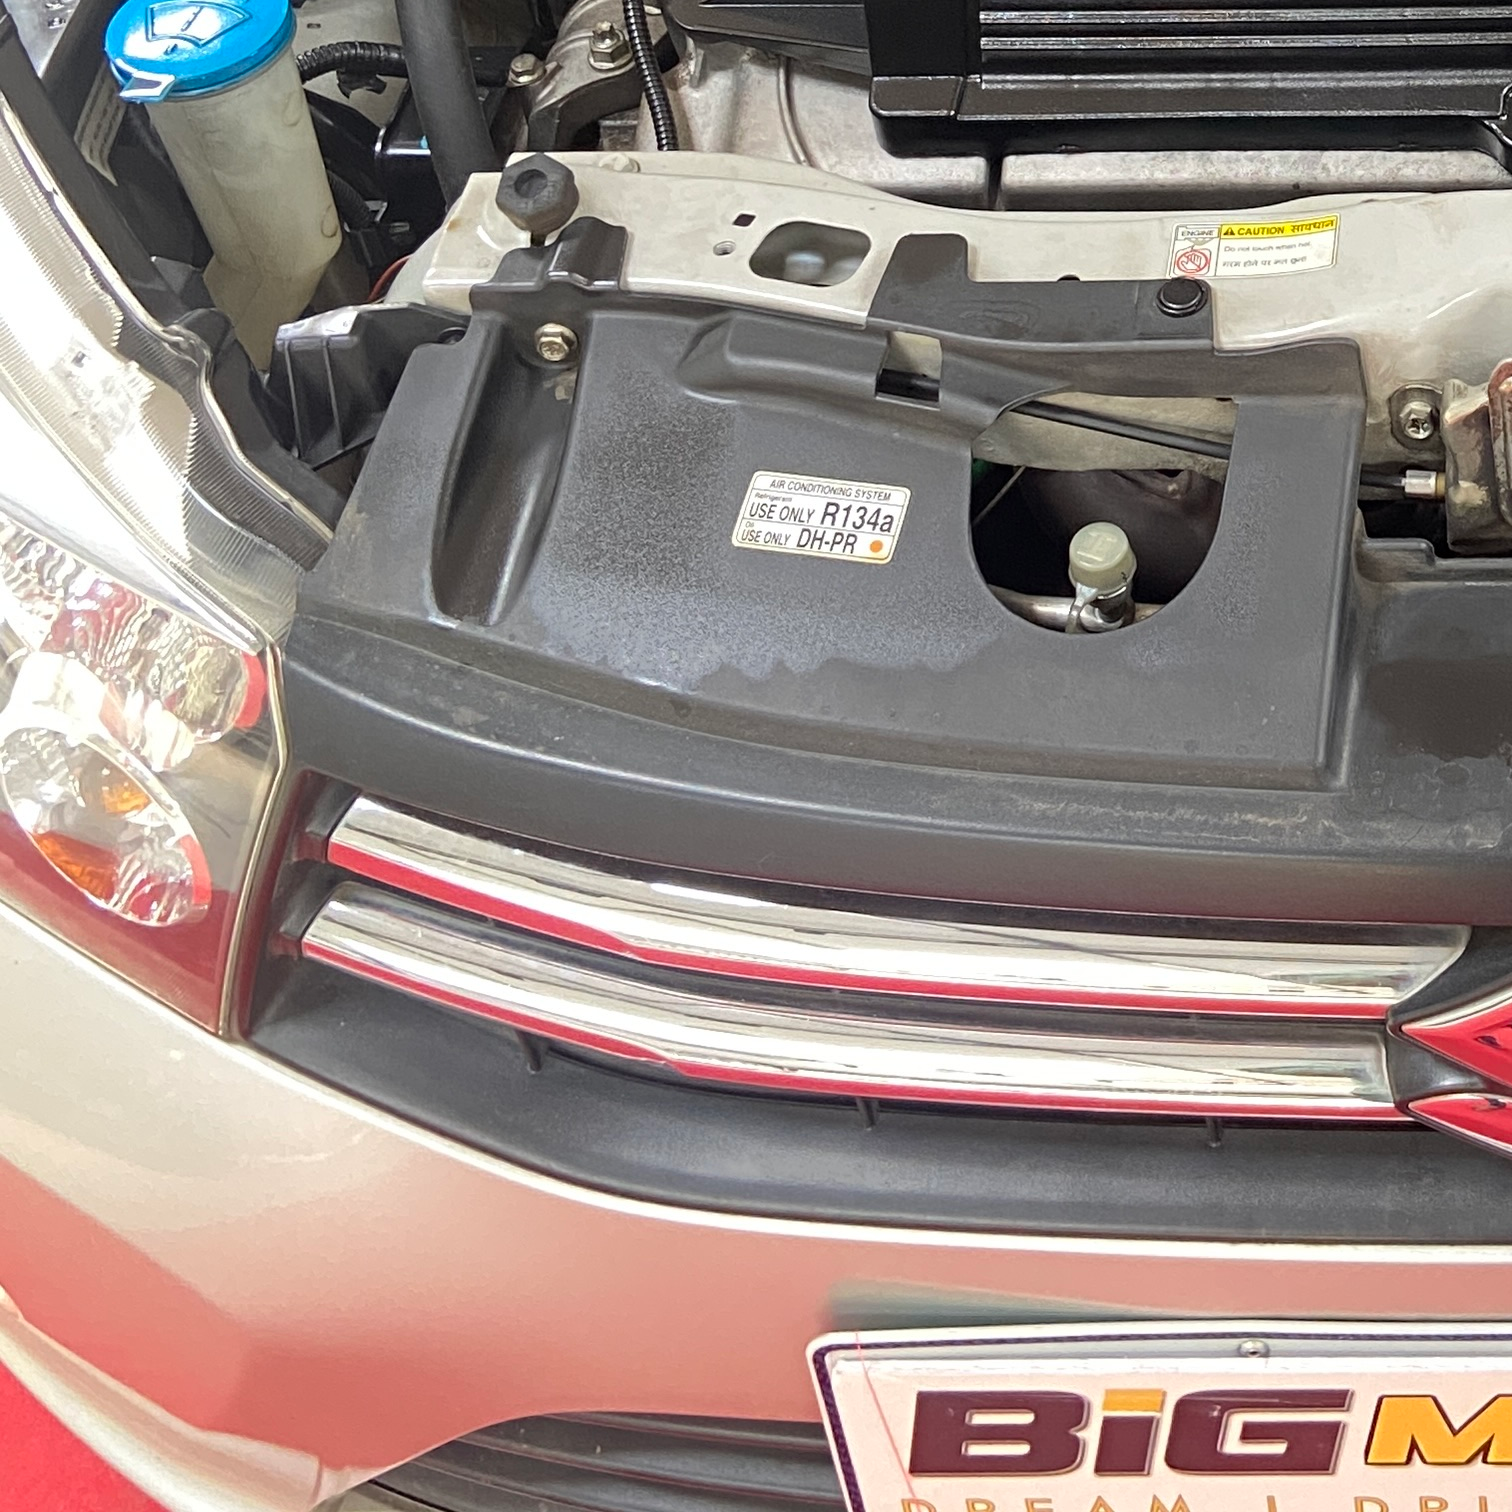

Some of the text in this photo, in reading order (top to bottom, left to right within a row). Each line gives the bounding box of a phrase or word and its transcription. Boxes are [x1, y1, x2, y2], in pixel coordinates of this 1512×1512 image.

[1181, 229, 1214, 237] ENGINE
[1237, 226, 1285, 236] CAUTION
[1290, 219, 1334, 233] सावधान
[770, 479, 891, 501] AIR CONDITIONING SYSTEM
[749, 501, 894, 533] USE ONLY R134a
[741, 528, 858, 554] USE ONLY DH-PR
